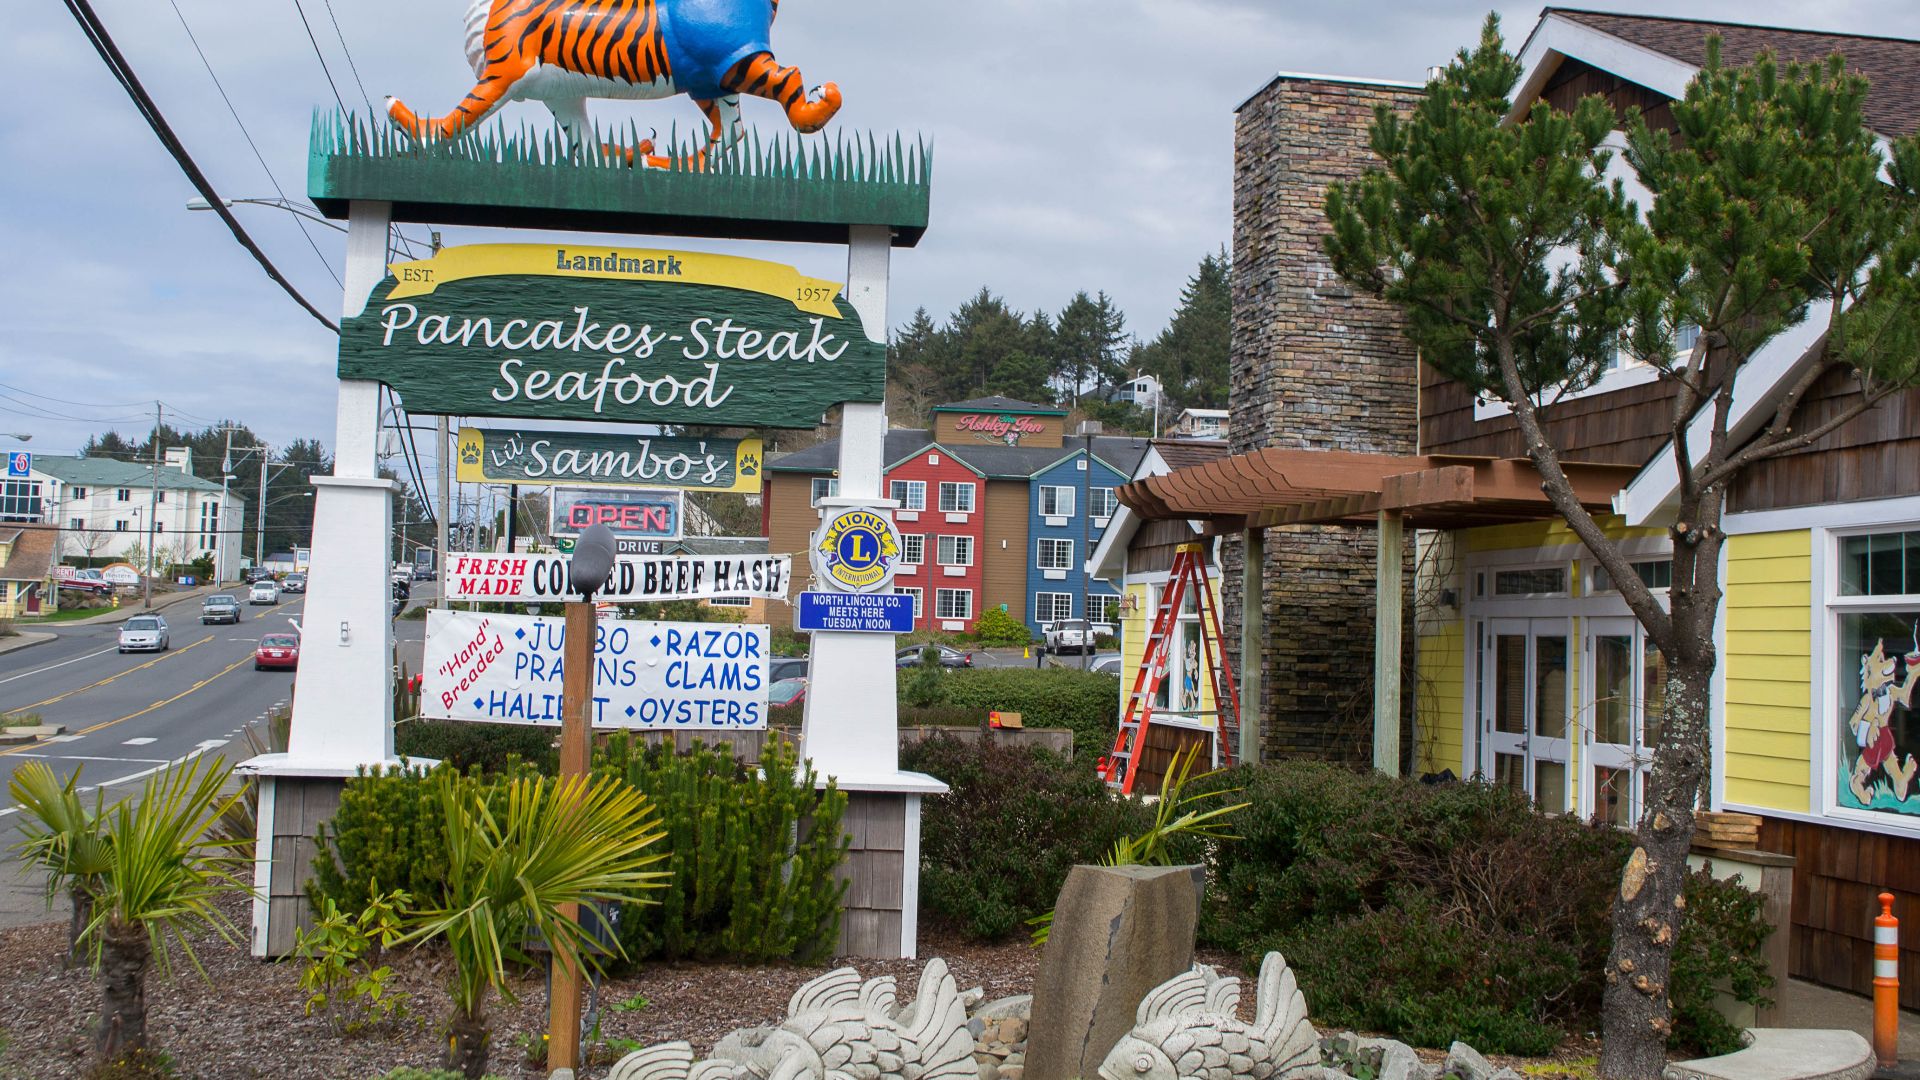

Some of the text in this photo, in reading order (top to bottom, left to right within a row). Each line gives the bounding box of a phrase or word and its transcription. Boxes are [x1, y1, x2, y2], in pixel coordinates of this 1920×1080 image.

[403, 268, 435, 283] EST.
[556, 250, 682, 276] Landmark
[796, 287, 831, 302] 1957
[492, 358, 734, 413] Seafood
[956, 414, 1045, 437] Ashley Inn
[15, 453, 28, 472] 6
[524, 439, 729, 484] Sambo's
[568, 504, 667, 531] OPEN
[838, 514, 884, 531] LIONS
[618, 541, 659, 553] DRIVE
[850, 535, 871, 562] L
[455, 558, 529, 576] FRESH
[533, 559, 782, 596] COED BEEF HASH
[836, 568, 881, 583] INTERNATIONAL
[458, 578, 523, 596] MADE
[813, 594, 901, 608] NORTH LINCOLN CO.
[829, 607, 885, 618] MEETS HERE
[822, 617, 891, 629] TUESDAY NOON
[439, 618, 490, 677] "Hand"
[528, 623, 629, 655] JUBO
[666, 629, 760, 659] RAZOR
[441, 634, 505, 711] Breaded
[515, 652, 637, 687] PRANS
[665, 661, 761, 691] CLAMS
[488, 690, 610, 722] HALIT
[639, 698, 759, 725] OYSTERS
